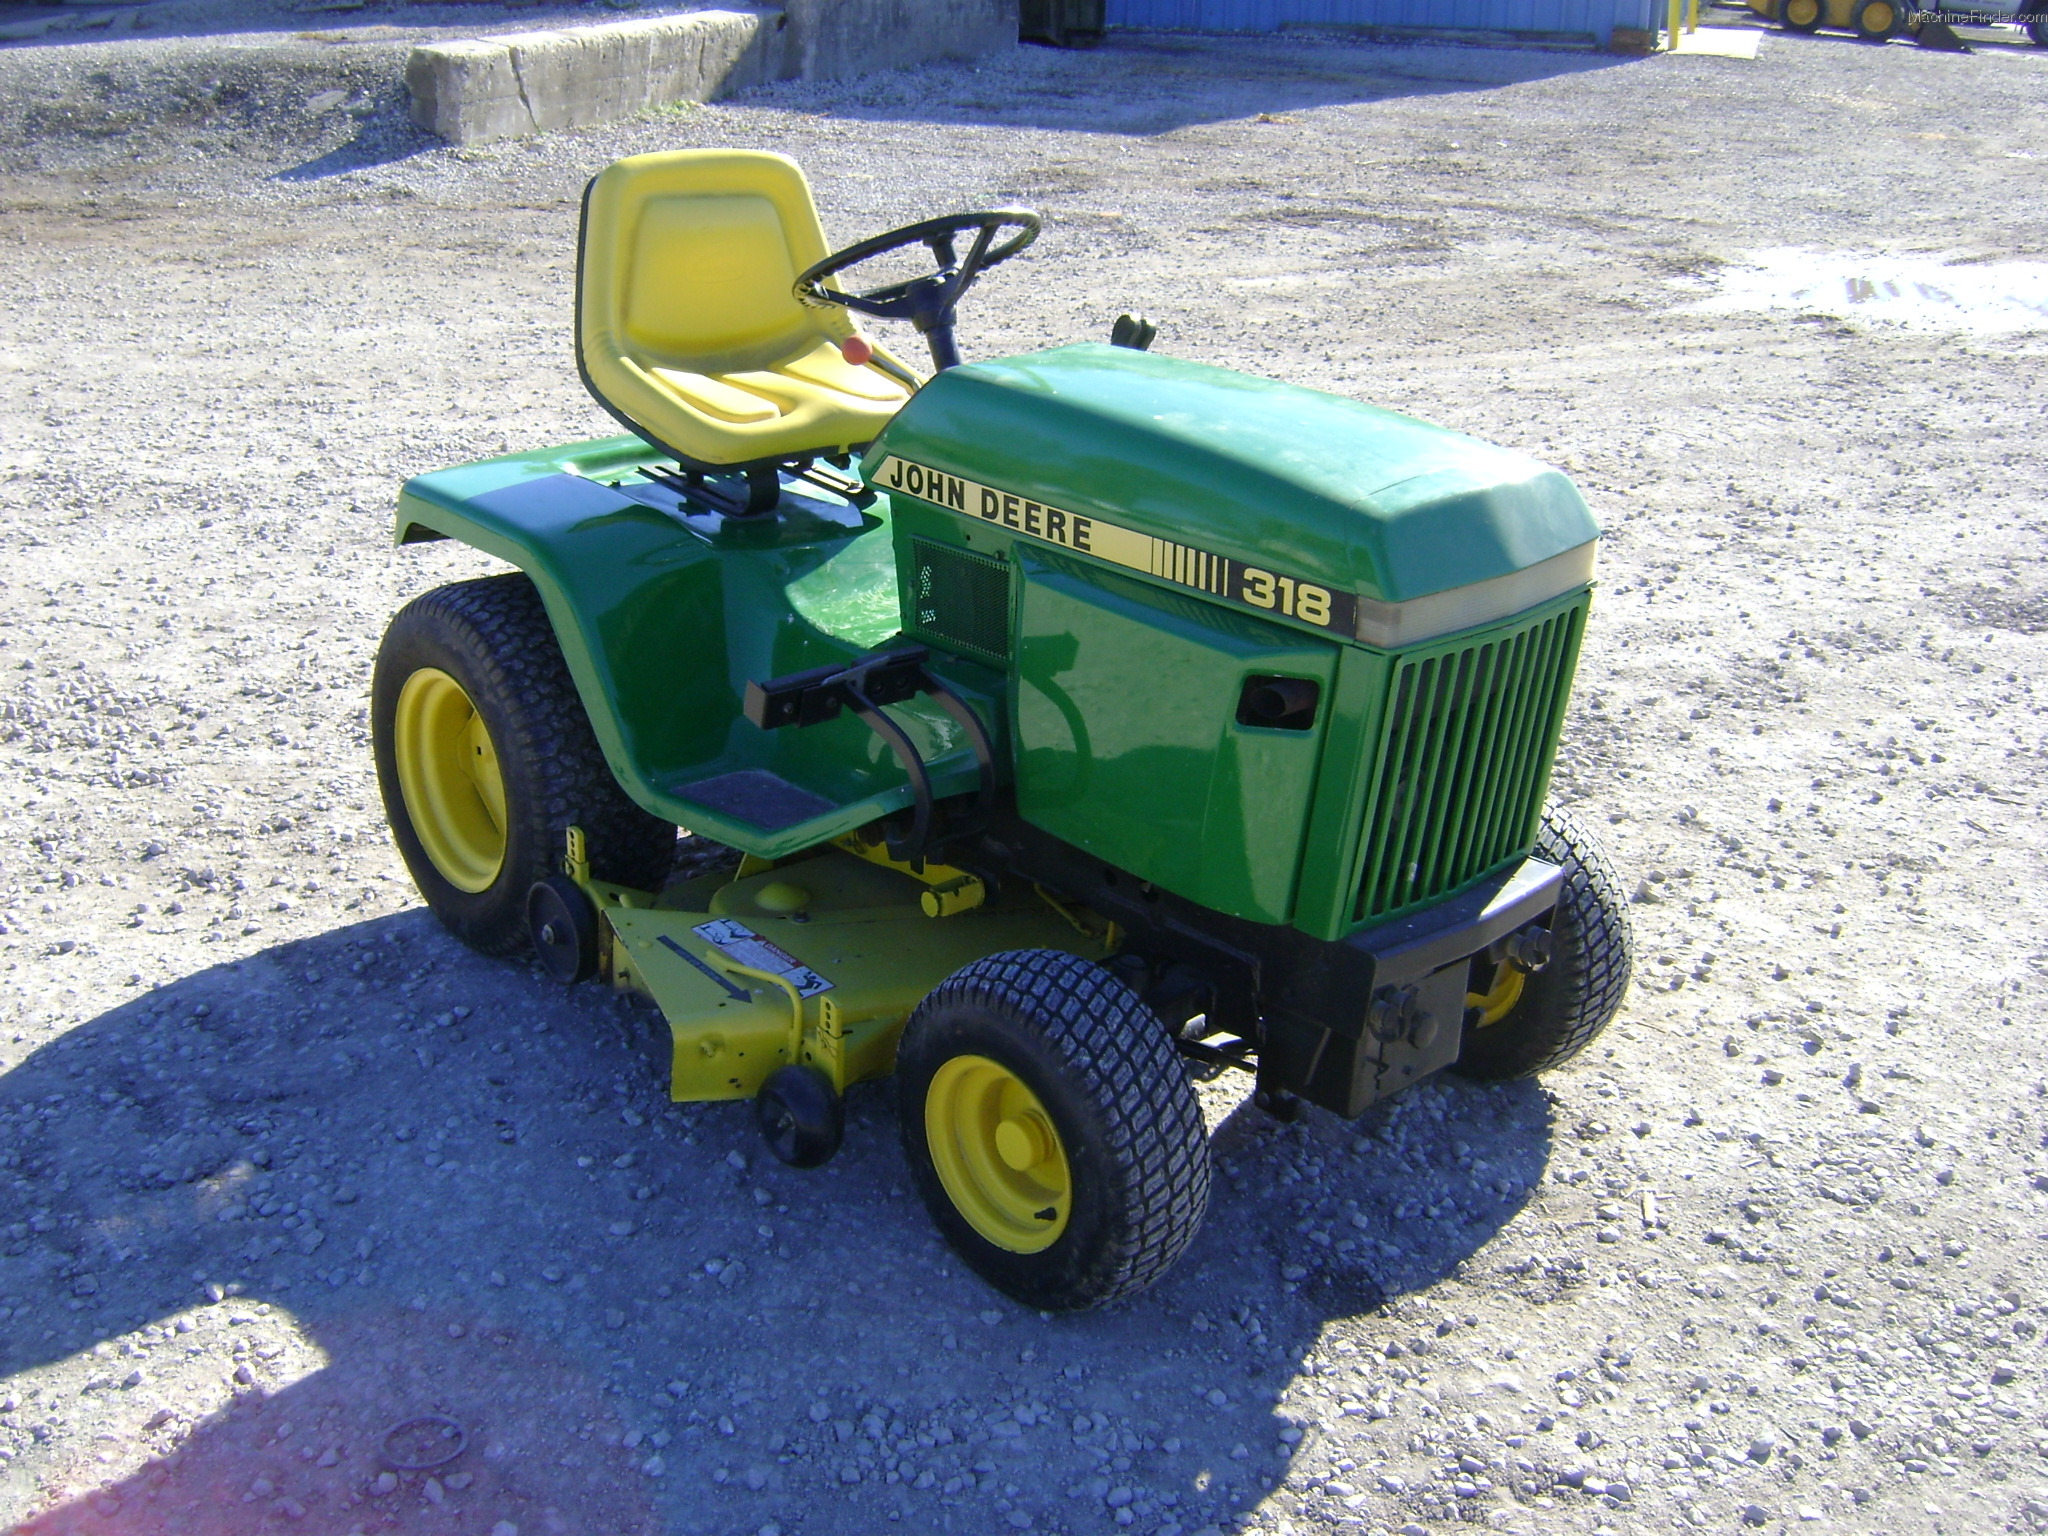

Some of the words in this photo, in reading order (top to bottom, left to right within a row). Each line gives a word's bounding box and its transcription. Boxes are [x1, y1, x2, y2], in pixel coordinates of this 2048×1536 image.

[890, 460, 965, 510] JOHN
[981, 488, 1091, 551] DEERE
[1243, 567, 1331, 626] 318
[764, 943, 796, 963] DANGER
